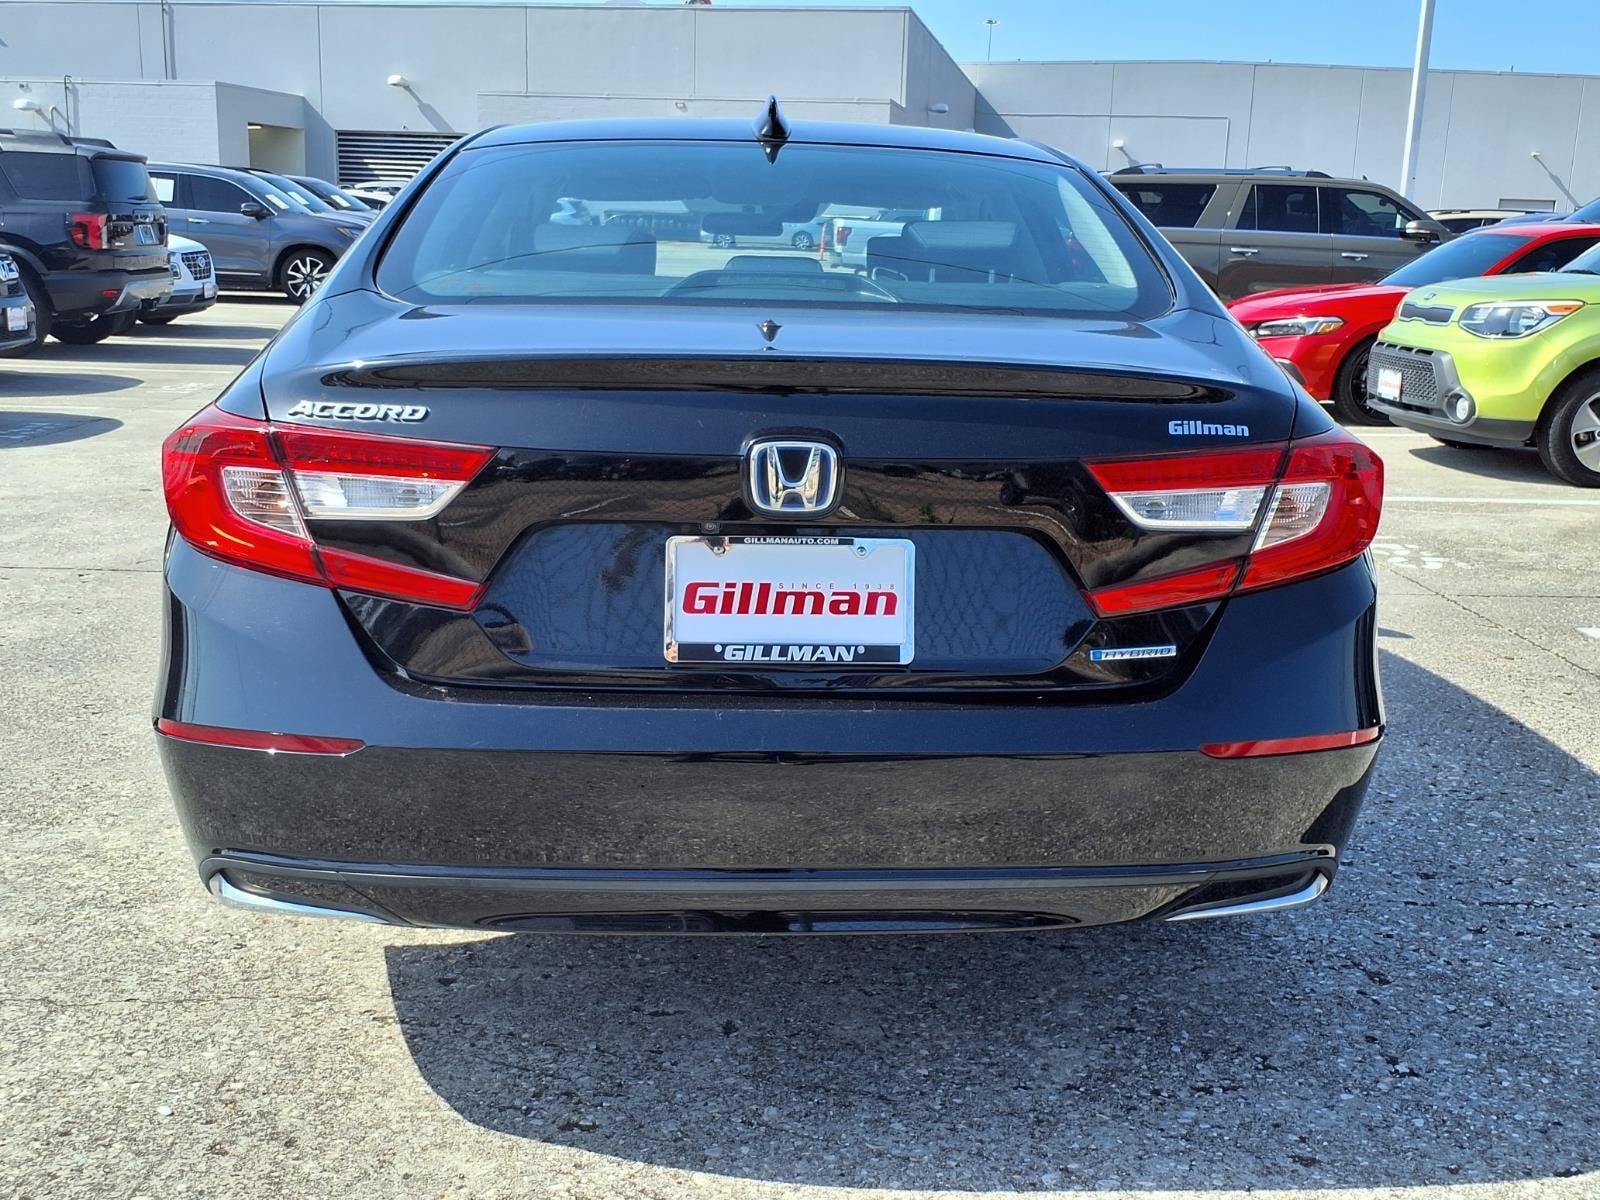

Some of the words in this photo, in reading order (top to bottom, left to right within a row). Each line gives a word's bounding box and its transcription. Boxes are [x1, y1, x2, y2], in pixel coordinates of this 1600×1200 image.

[288, 401, 429, 422] ACCORD
[1168, 420, 1249, 436] Gillman
[744, 537, 839, 545] GILLMANAUTO.COM
[778, 582, 835, 590] SINCE
[682, 582, 898, 615] Gillman
[724, 645, 856, 661] GILLMAN
[1104, 647, 1172, 658] HYBRID
